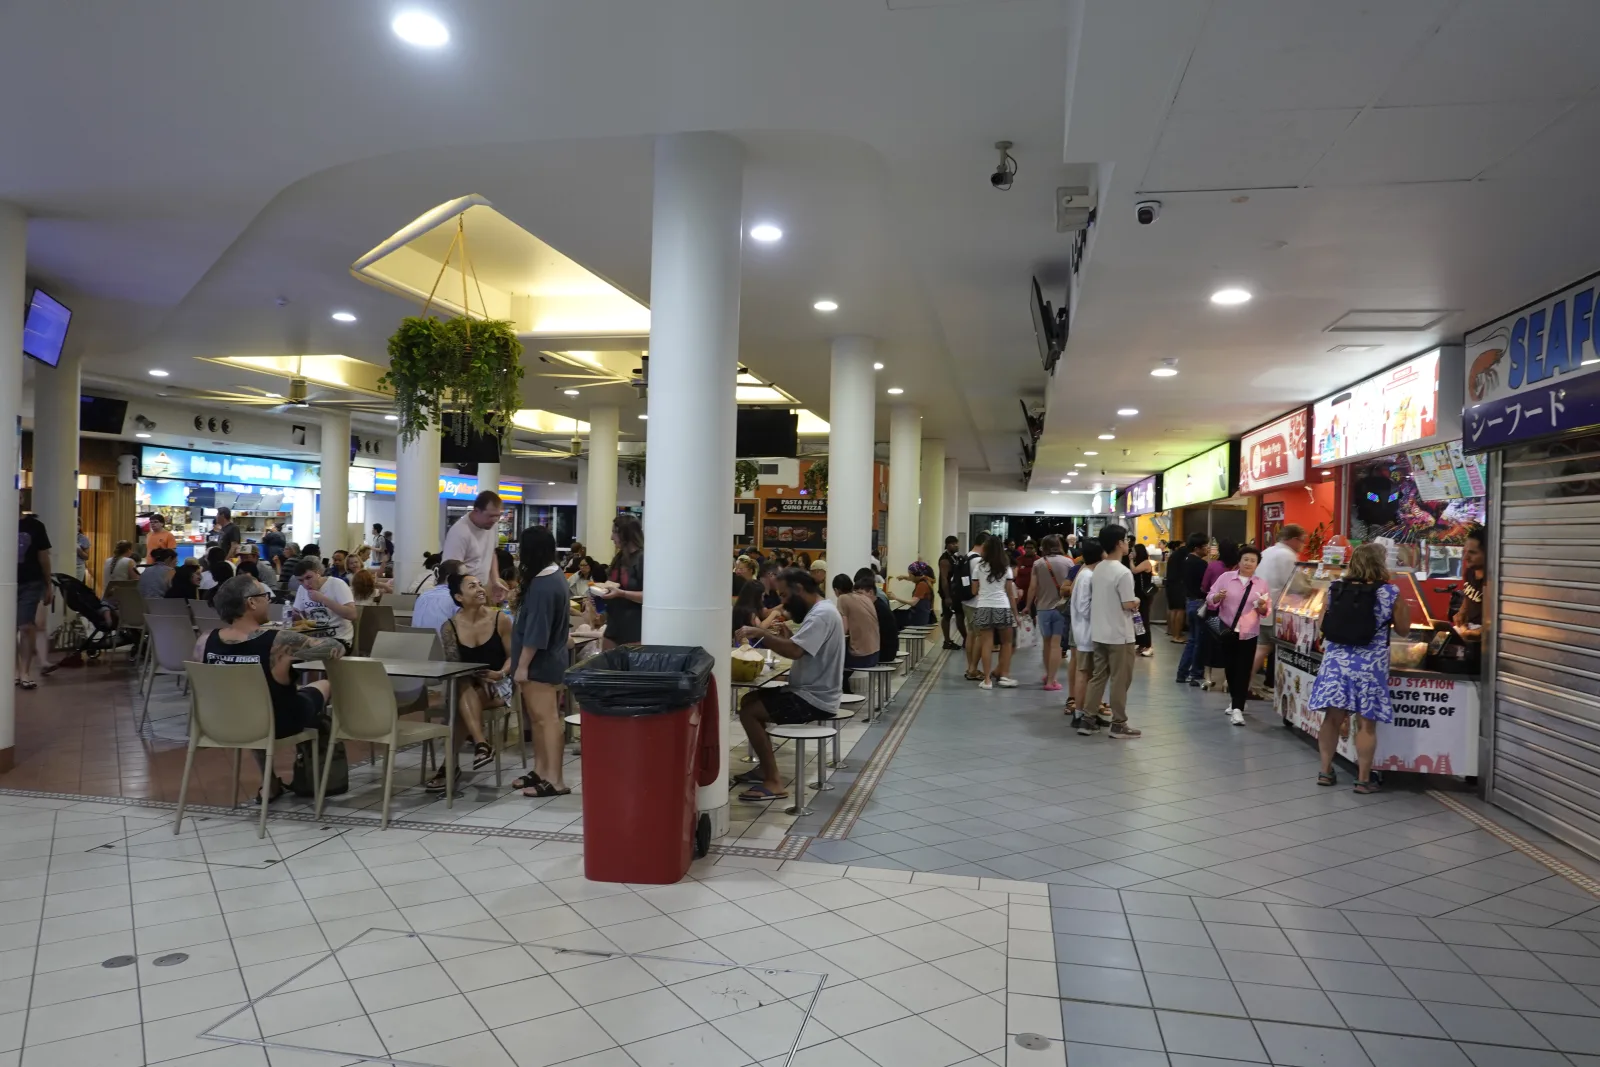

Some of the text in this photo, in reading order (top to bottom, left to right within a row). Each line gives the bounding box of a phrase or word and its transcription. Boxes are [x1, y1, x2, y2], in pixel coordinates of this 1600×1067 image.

[1471, 389, 1566, 442] シーフード
[190, 455, 221, 475] Blue
[223, 459, 270, 480] Lagoon
[235, 655, 259, 663] DESIGNS
[1387, 677, 1455, 690] OD STATION
[1388, 690, 1449, 702] ASTE THE
[1391, 703, 1456, 717] VOURS OF
[1394, 717, 1430, 729] INDIA
